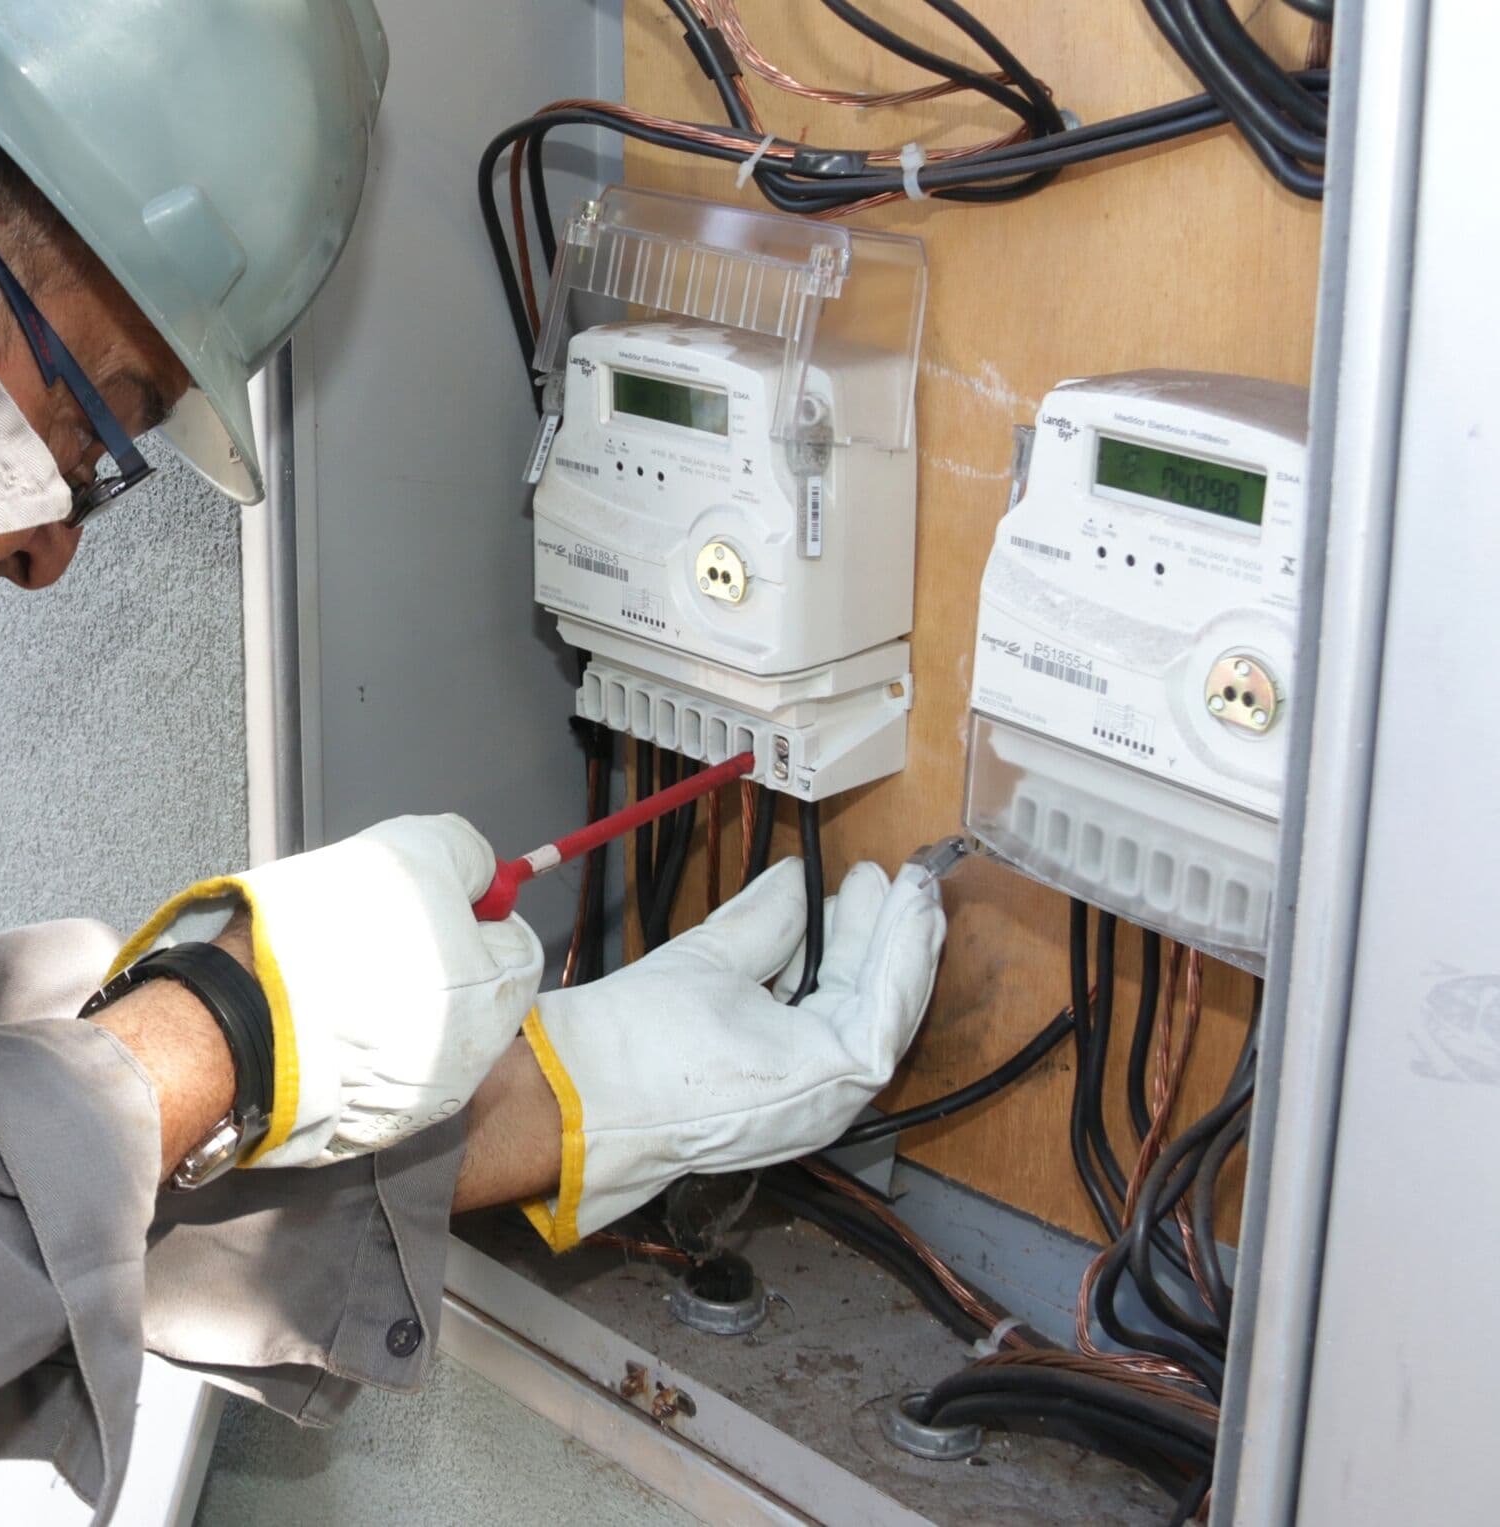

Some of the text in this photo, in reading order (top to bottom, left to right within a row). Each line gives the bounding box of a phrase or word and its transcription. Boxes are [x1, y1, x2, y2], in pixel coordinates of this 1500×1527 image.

[569, 354, 590, 367] Landis
[1042, 413, 1072, 430] Landis
[1033, 641, 1094, 672] P51855-4
